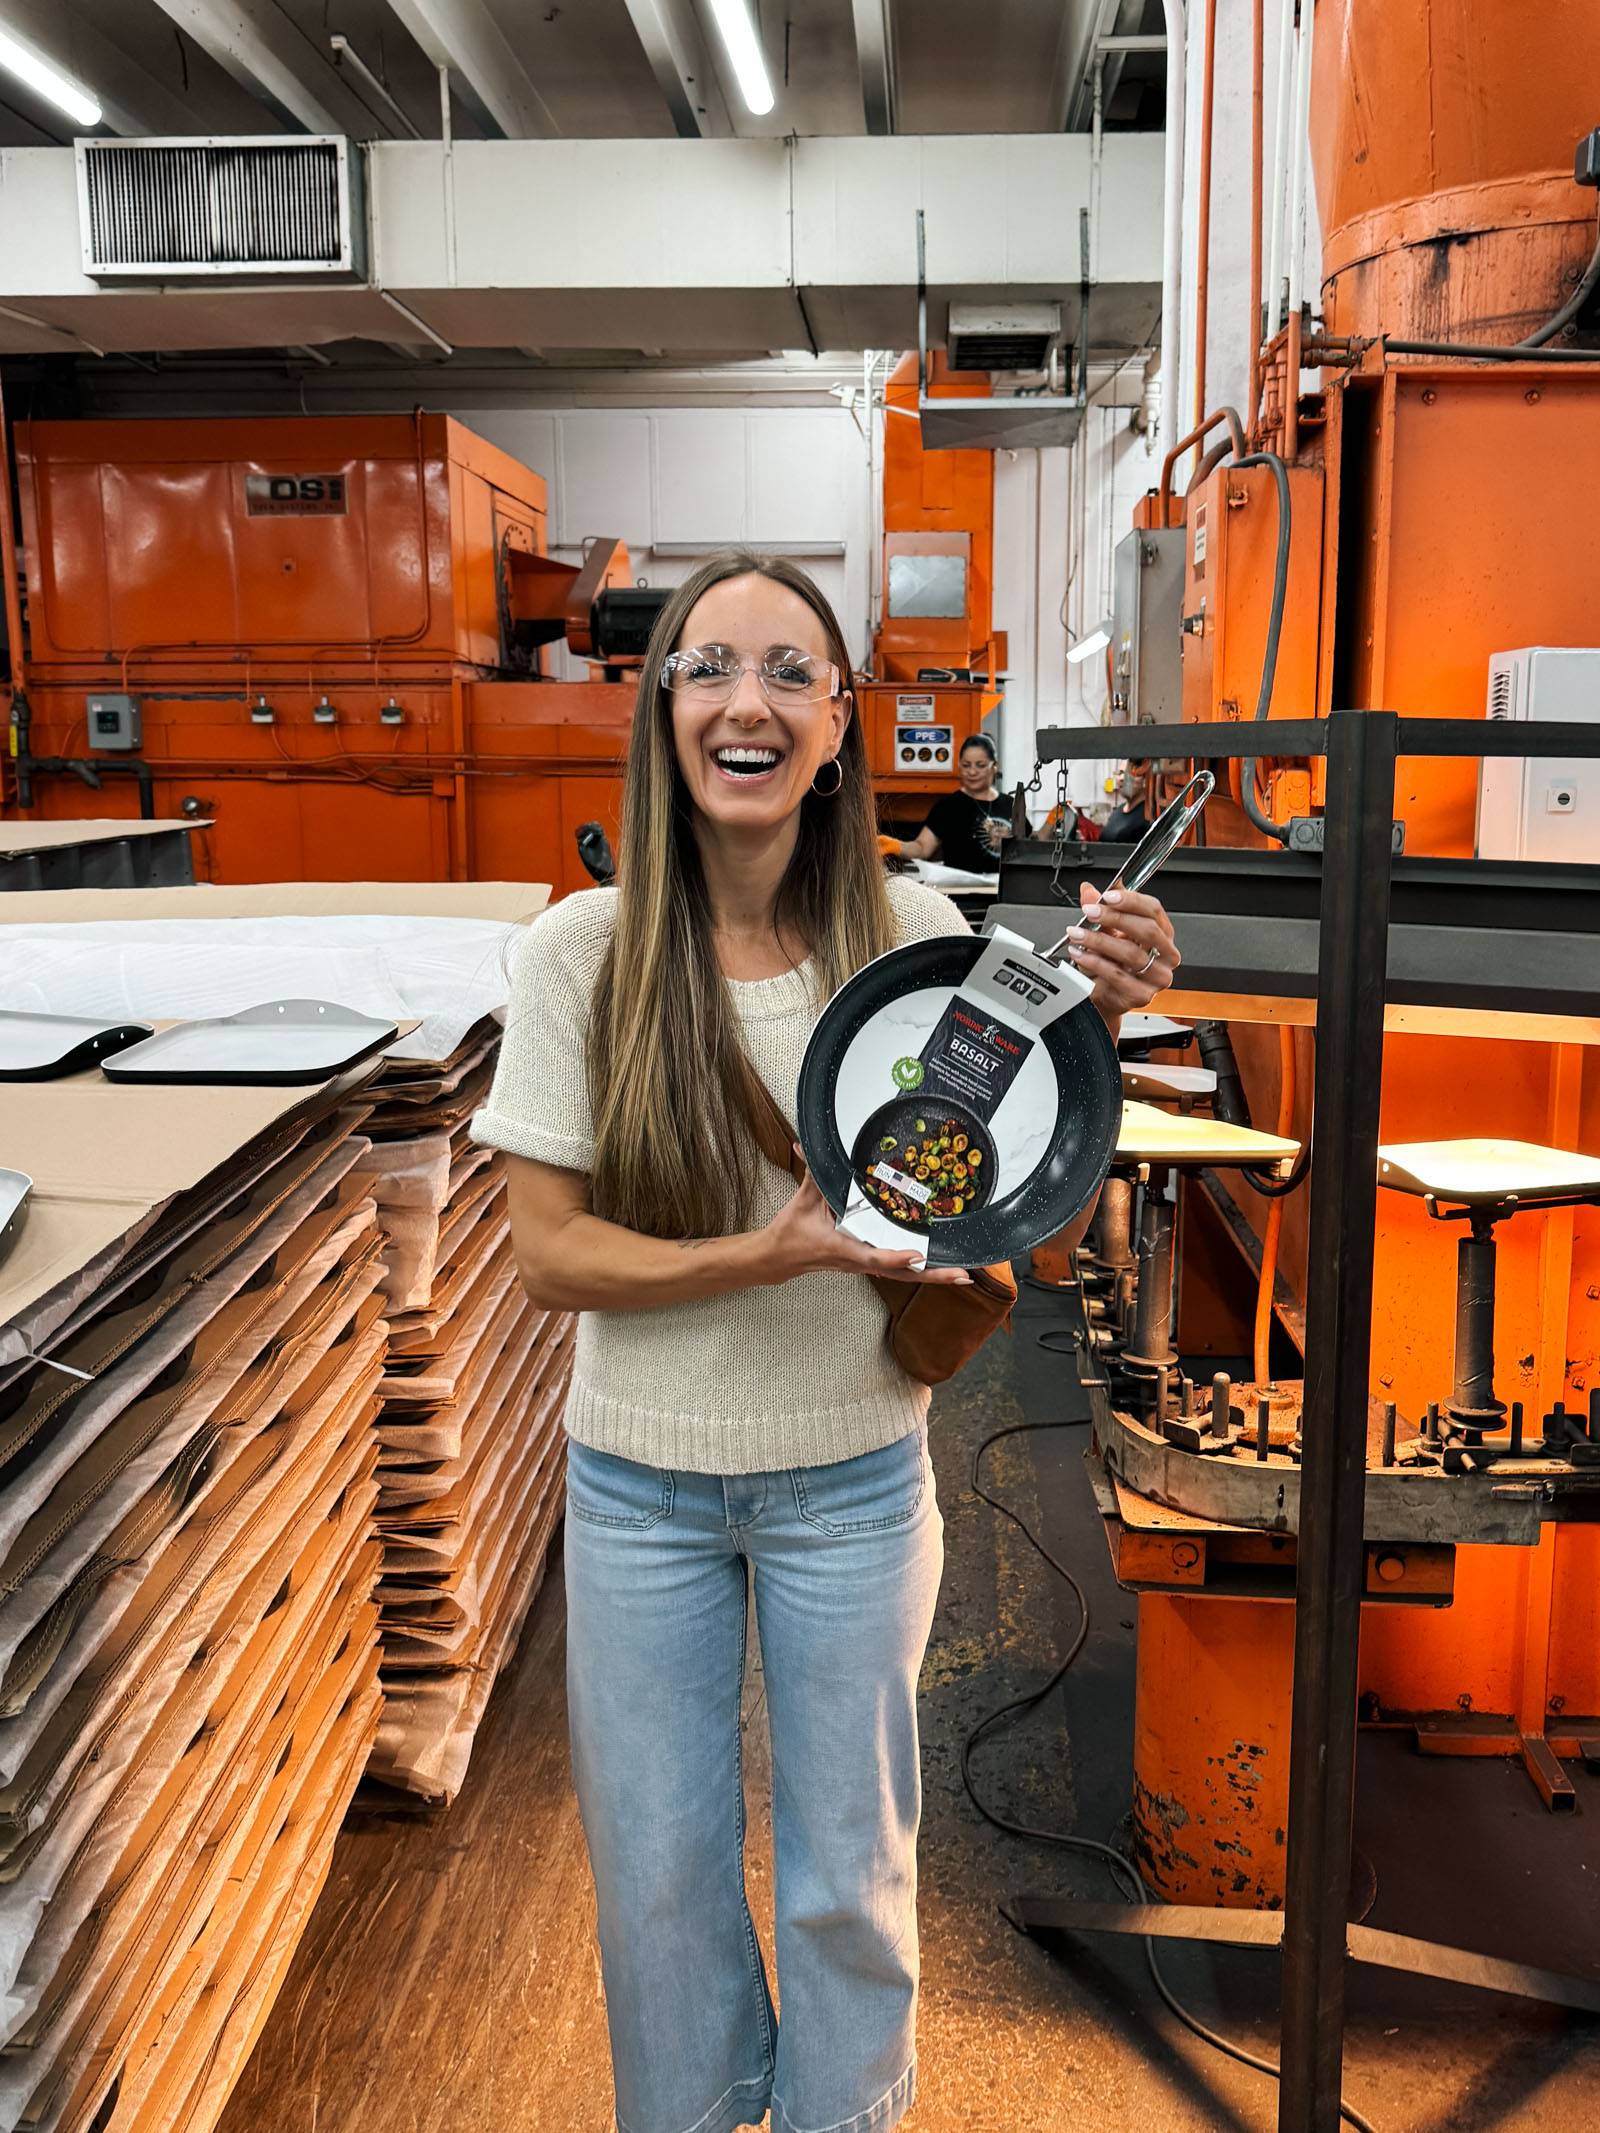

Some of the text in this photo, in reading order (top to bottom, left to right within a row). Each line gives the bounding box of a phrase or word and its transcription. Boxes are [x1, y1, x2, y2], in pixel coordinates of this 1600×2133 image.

[915, 732, 936, 742] PPE
[952, 1010, 1020, 1055] NORDIC WARE
[950, 1038, 999, 1072] BASALT
[877, 1167, 892, 1180] RUN
[910, 1186, 927, 1200] MADE
